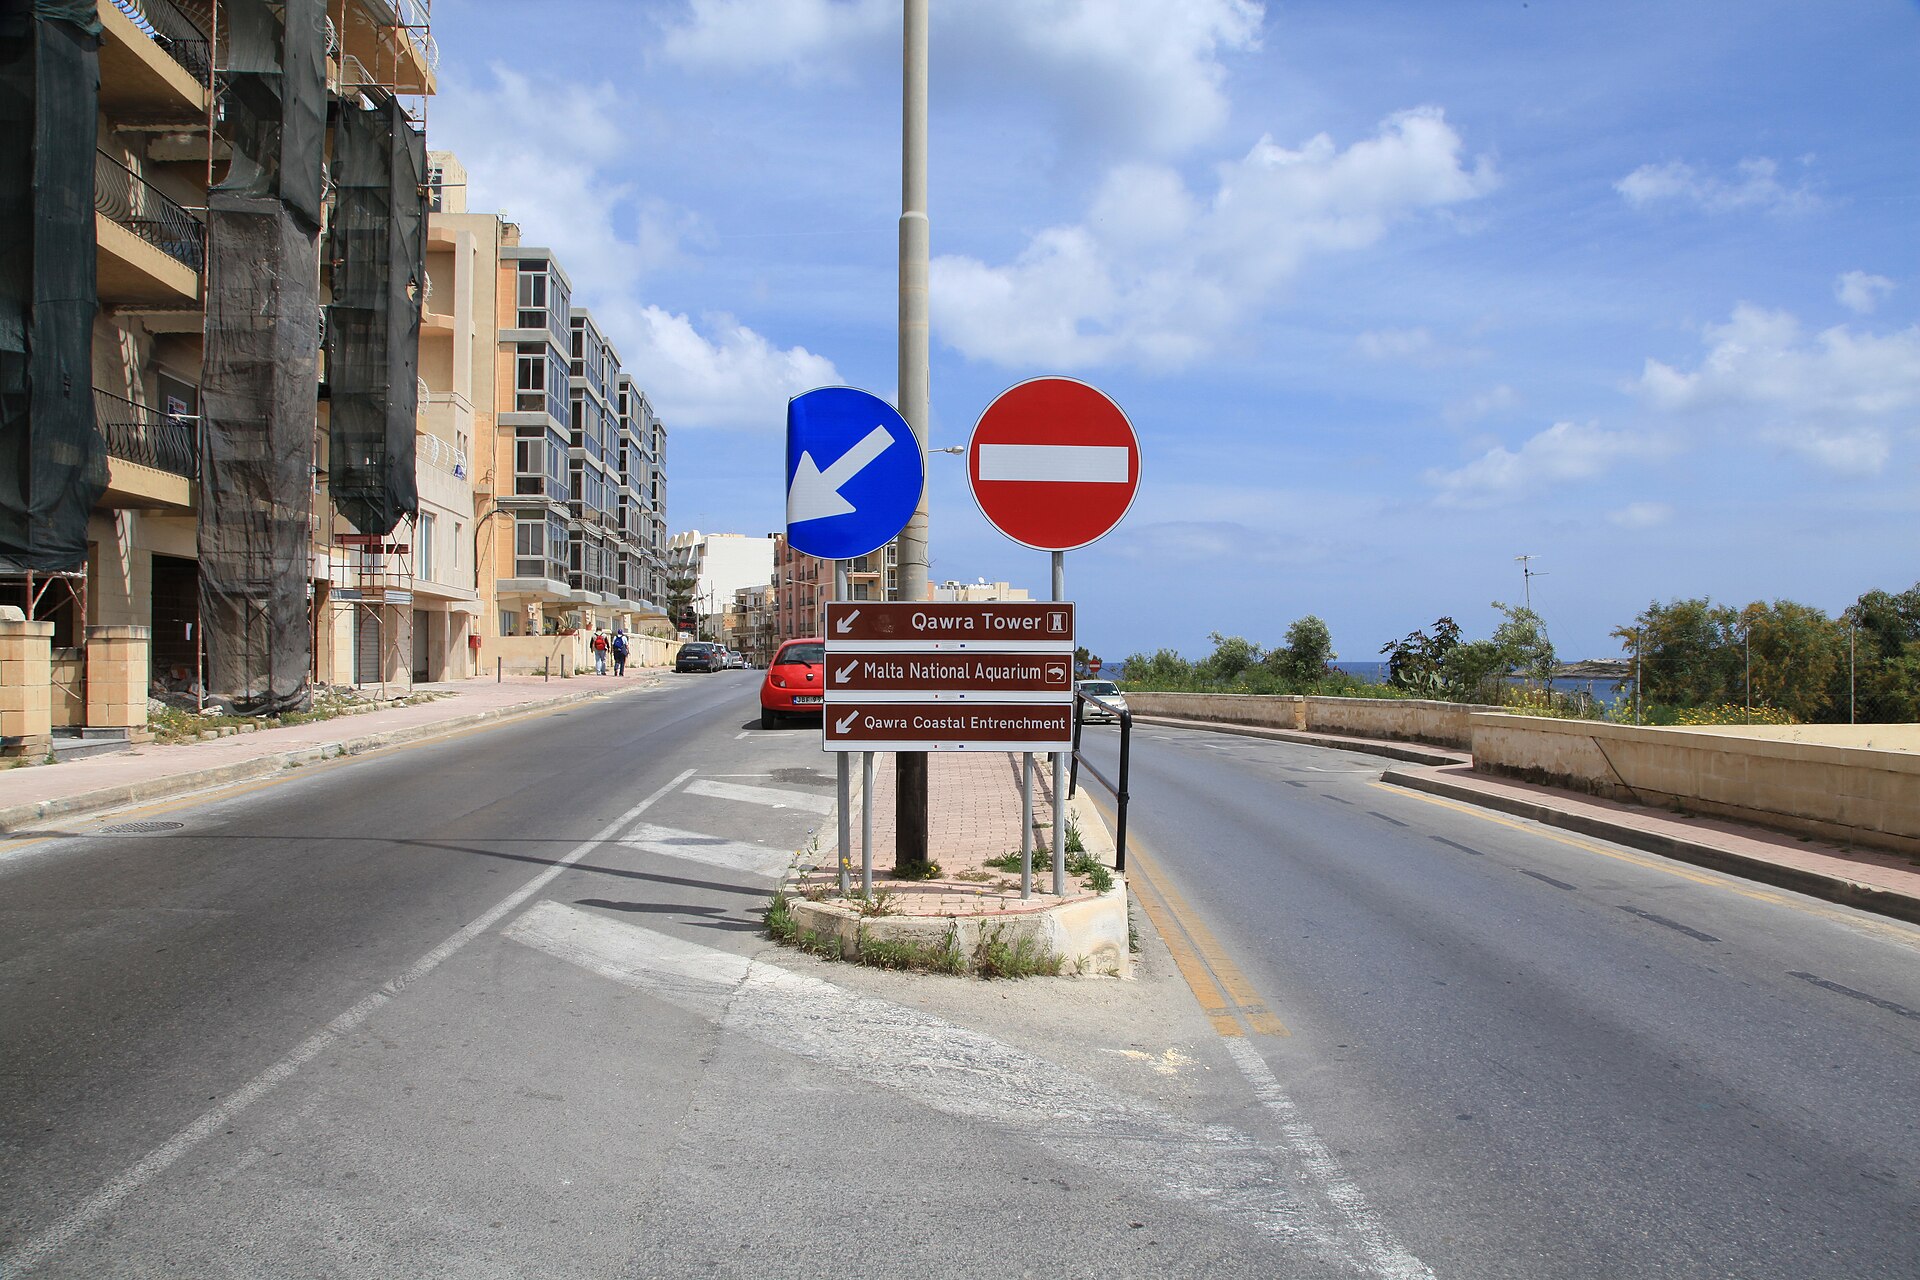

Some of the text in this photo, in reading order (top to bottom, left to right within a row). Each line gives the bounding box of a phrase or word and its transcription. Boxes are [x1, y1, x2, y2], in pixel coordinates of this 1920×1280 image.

[912, 612, 1042, 631] Qawra Tower
[864, 662, 1041, 682] Malta National Aquarium
[864, 715, 1066, 730] Qawra Coastal Entrenchment
